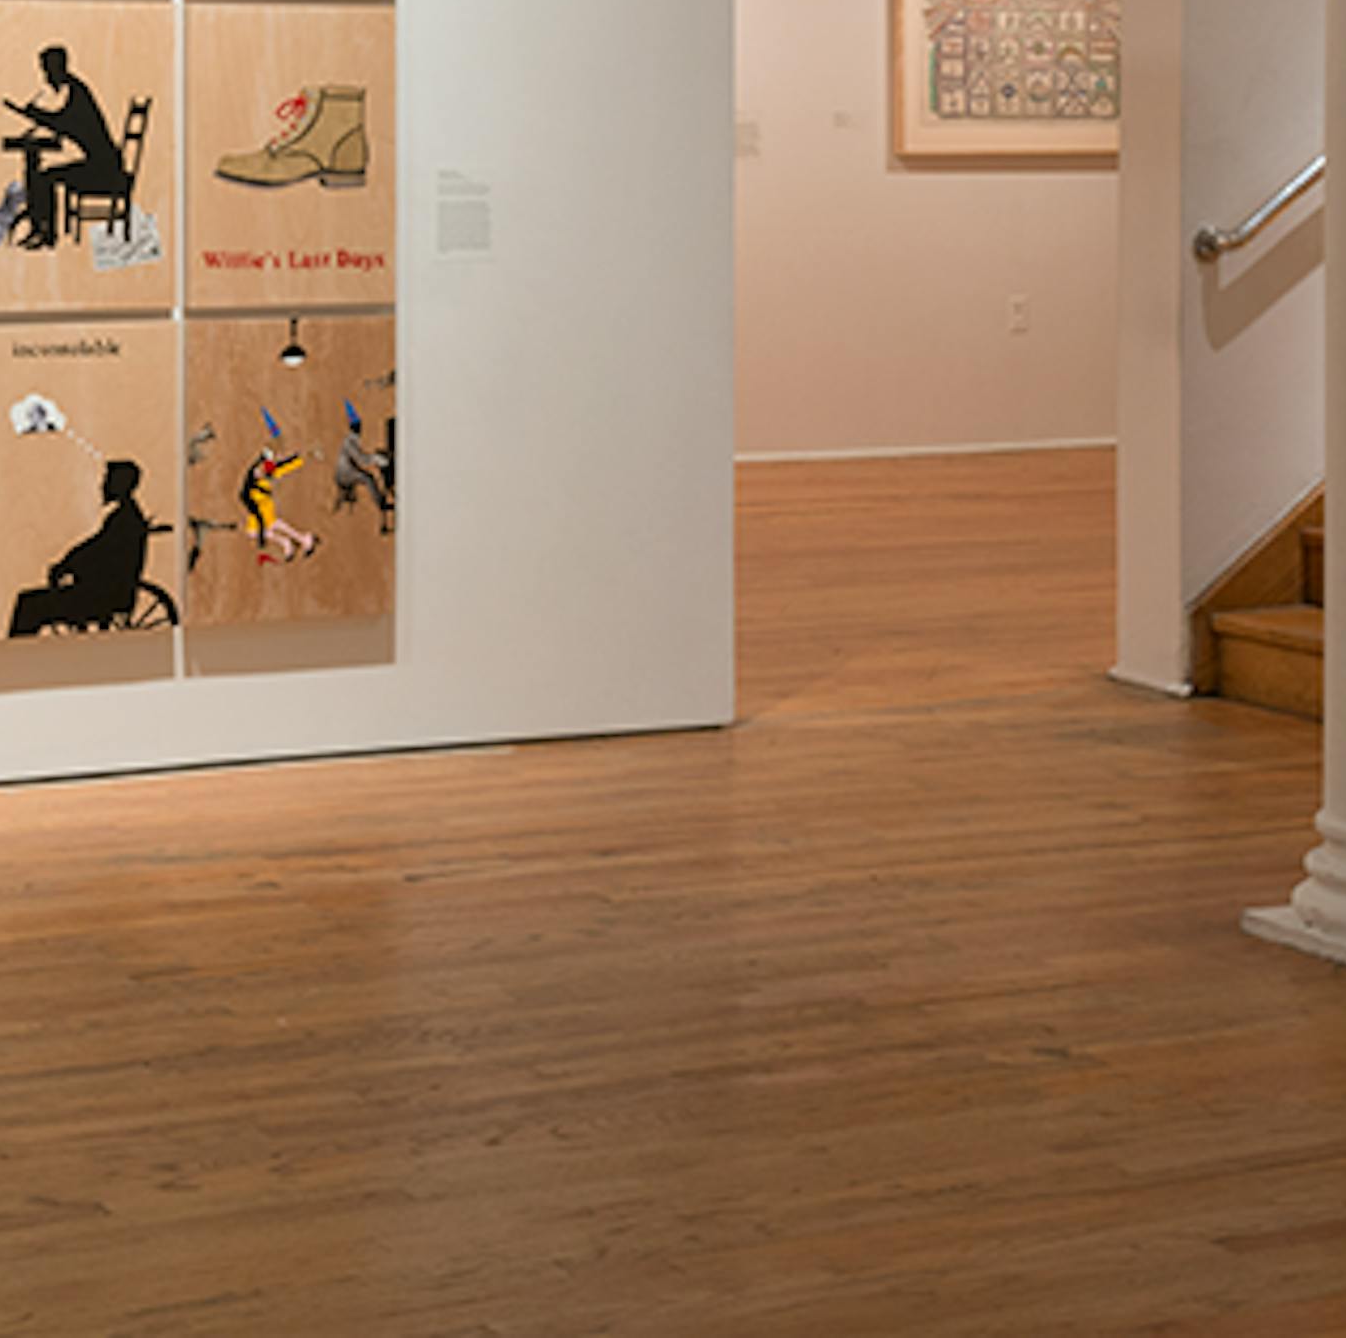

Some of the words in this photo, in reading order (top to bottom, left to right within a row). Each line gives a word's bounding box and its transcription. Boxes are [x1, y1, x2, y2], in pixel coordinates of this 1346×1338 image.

[203, 250, 281, 269] Willie's
[288, 250, 330, 269] Last
[337, 247, 384, 272] Days
